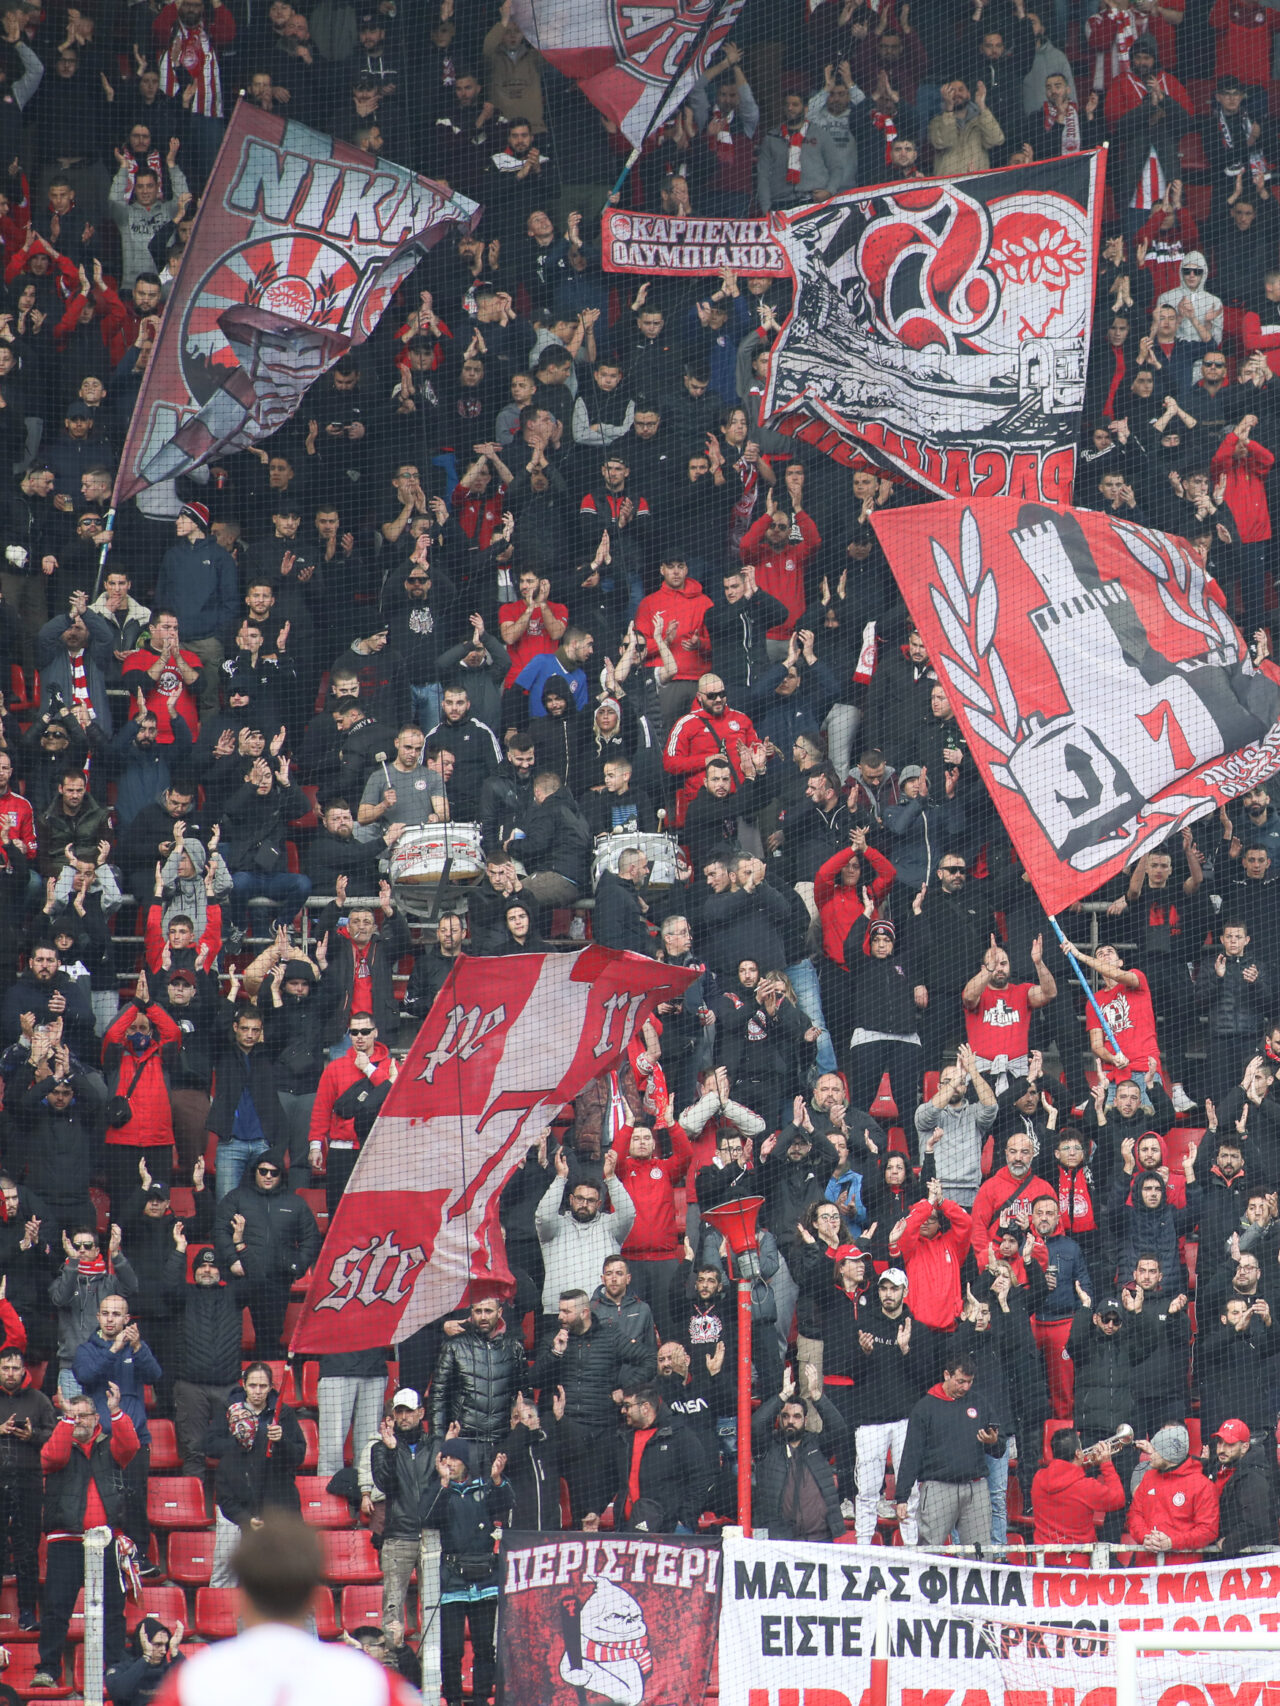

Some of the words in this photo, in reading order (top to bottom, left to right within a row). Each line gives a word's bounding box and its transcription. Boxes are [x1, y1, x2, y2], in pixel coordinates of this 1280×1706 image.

[613, 241, 784, 268] ΟΛΥΜΠΙΑΚΟΣ
[504, 1540, 720, 1594] ΠΕΡΙΣΤΕΡΙ
[734, 1560, 829, 1601] ΜΑΖΙ
[841, 1565, 912, 1602] ΣΑΣ
[919, 1566, 1027, 1606] ΦΙΔΙΑ
[1032, 1572, 1150, 1608] ΠΟΙΟΣ
[1157, 1571, 1214, 1604] ΝΑ
[761, 1615, 863, 1656] ΕΙΣΤΕ
